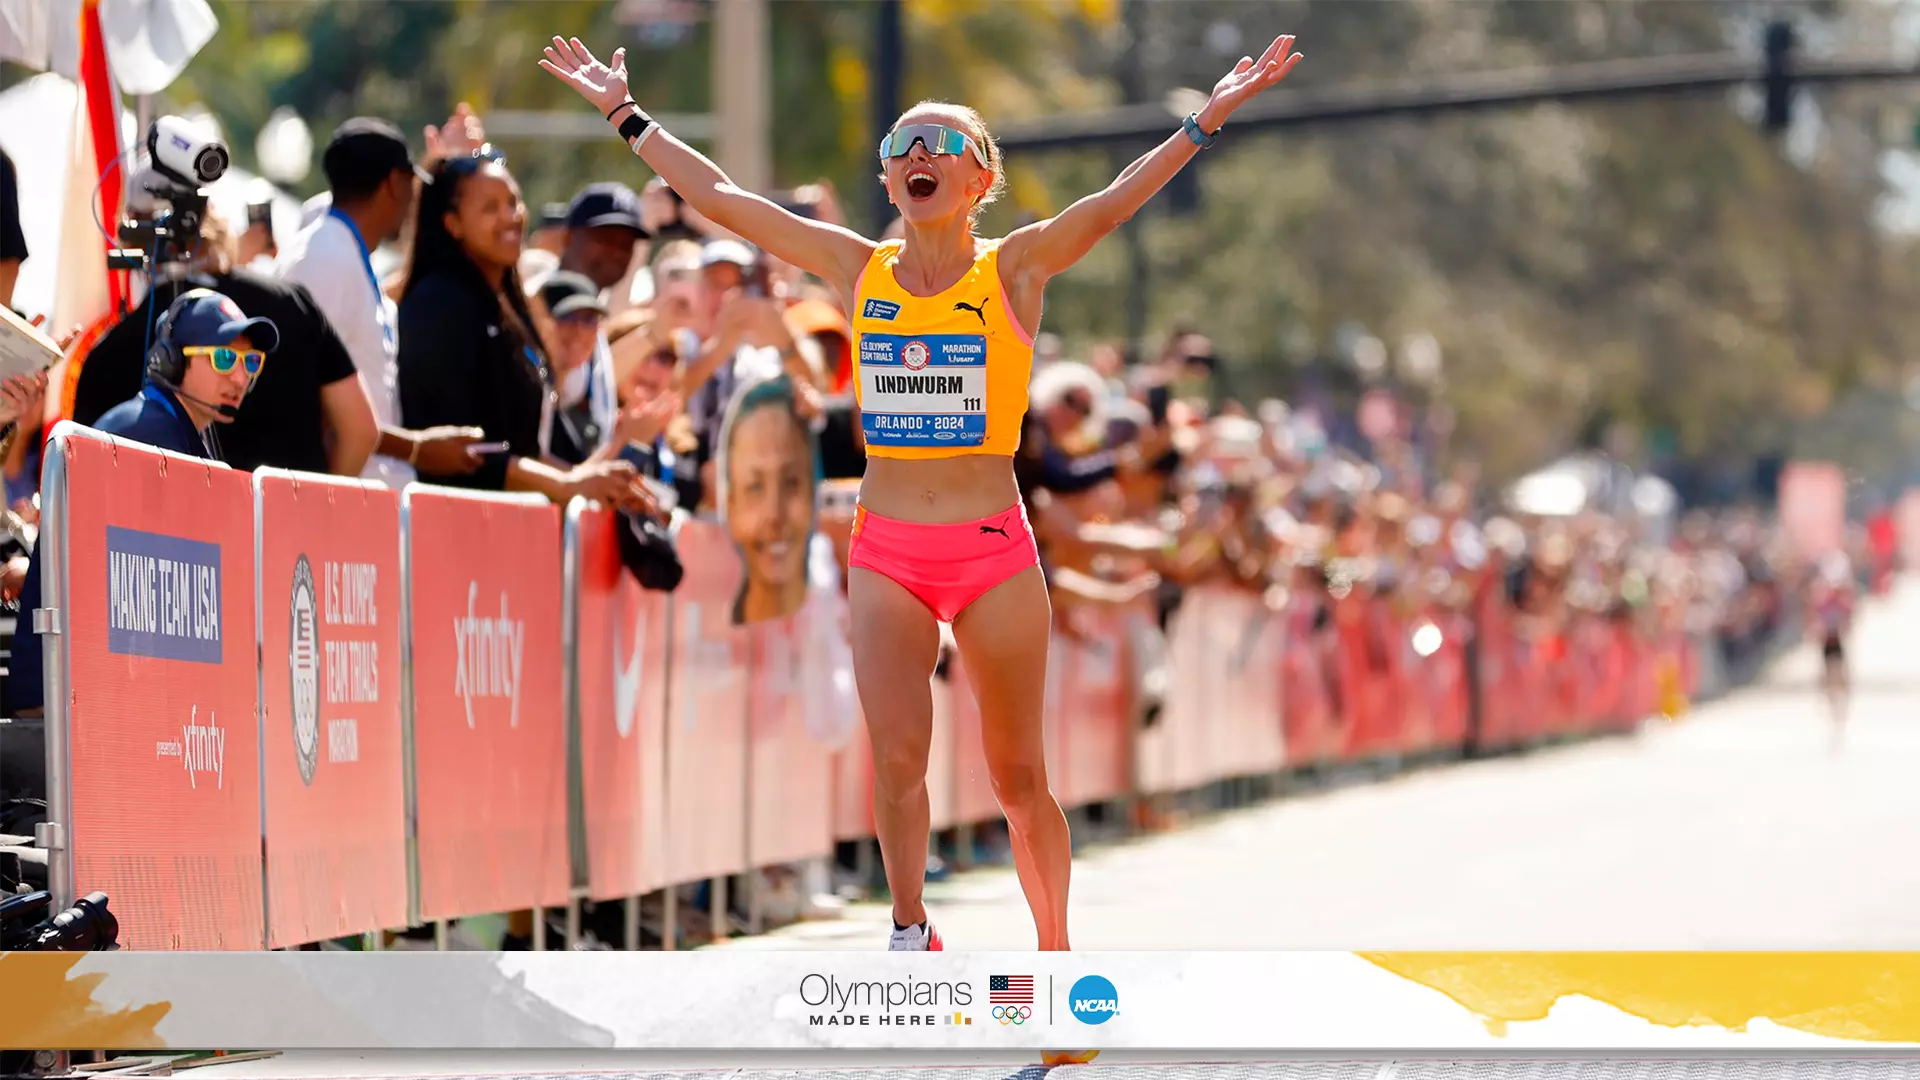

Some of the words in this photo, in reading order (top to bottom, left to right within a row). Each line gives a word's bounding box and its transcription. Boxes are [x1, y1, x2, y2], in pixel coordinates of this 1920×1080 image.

[869, 342, 893, 352] OLYMPIC
[873, 351, 894, 362] TRIALS
[942, 344, 982, 354] MARATHON
[875, 375, 963, 395] LINDWURM
[963, 397, 981, 411] 111
[875, 415, 923, 430] ORLANDO
[934, 416, 965, 430] 2024
[110, 551, 157, 634] MAKING
[158, 558, 191, 638] TEAM
[193, 563, 219, 641] USA
[342, 562, 378, 626] OLYMPIC
[453, 579, 525, 730] xfinity
[325, 640, 348, 703] TEAM
[349, 640, 379, 703] TRIALS
[182, 704, 225, 791] xfinity
